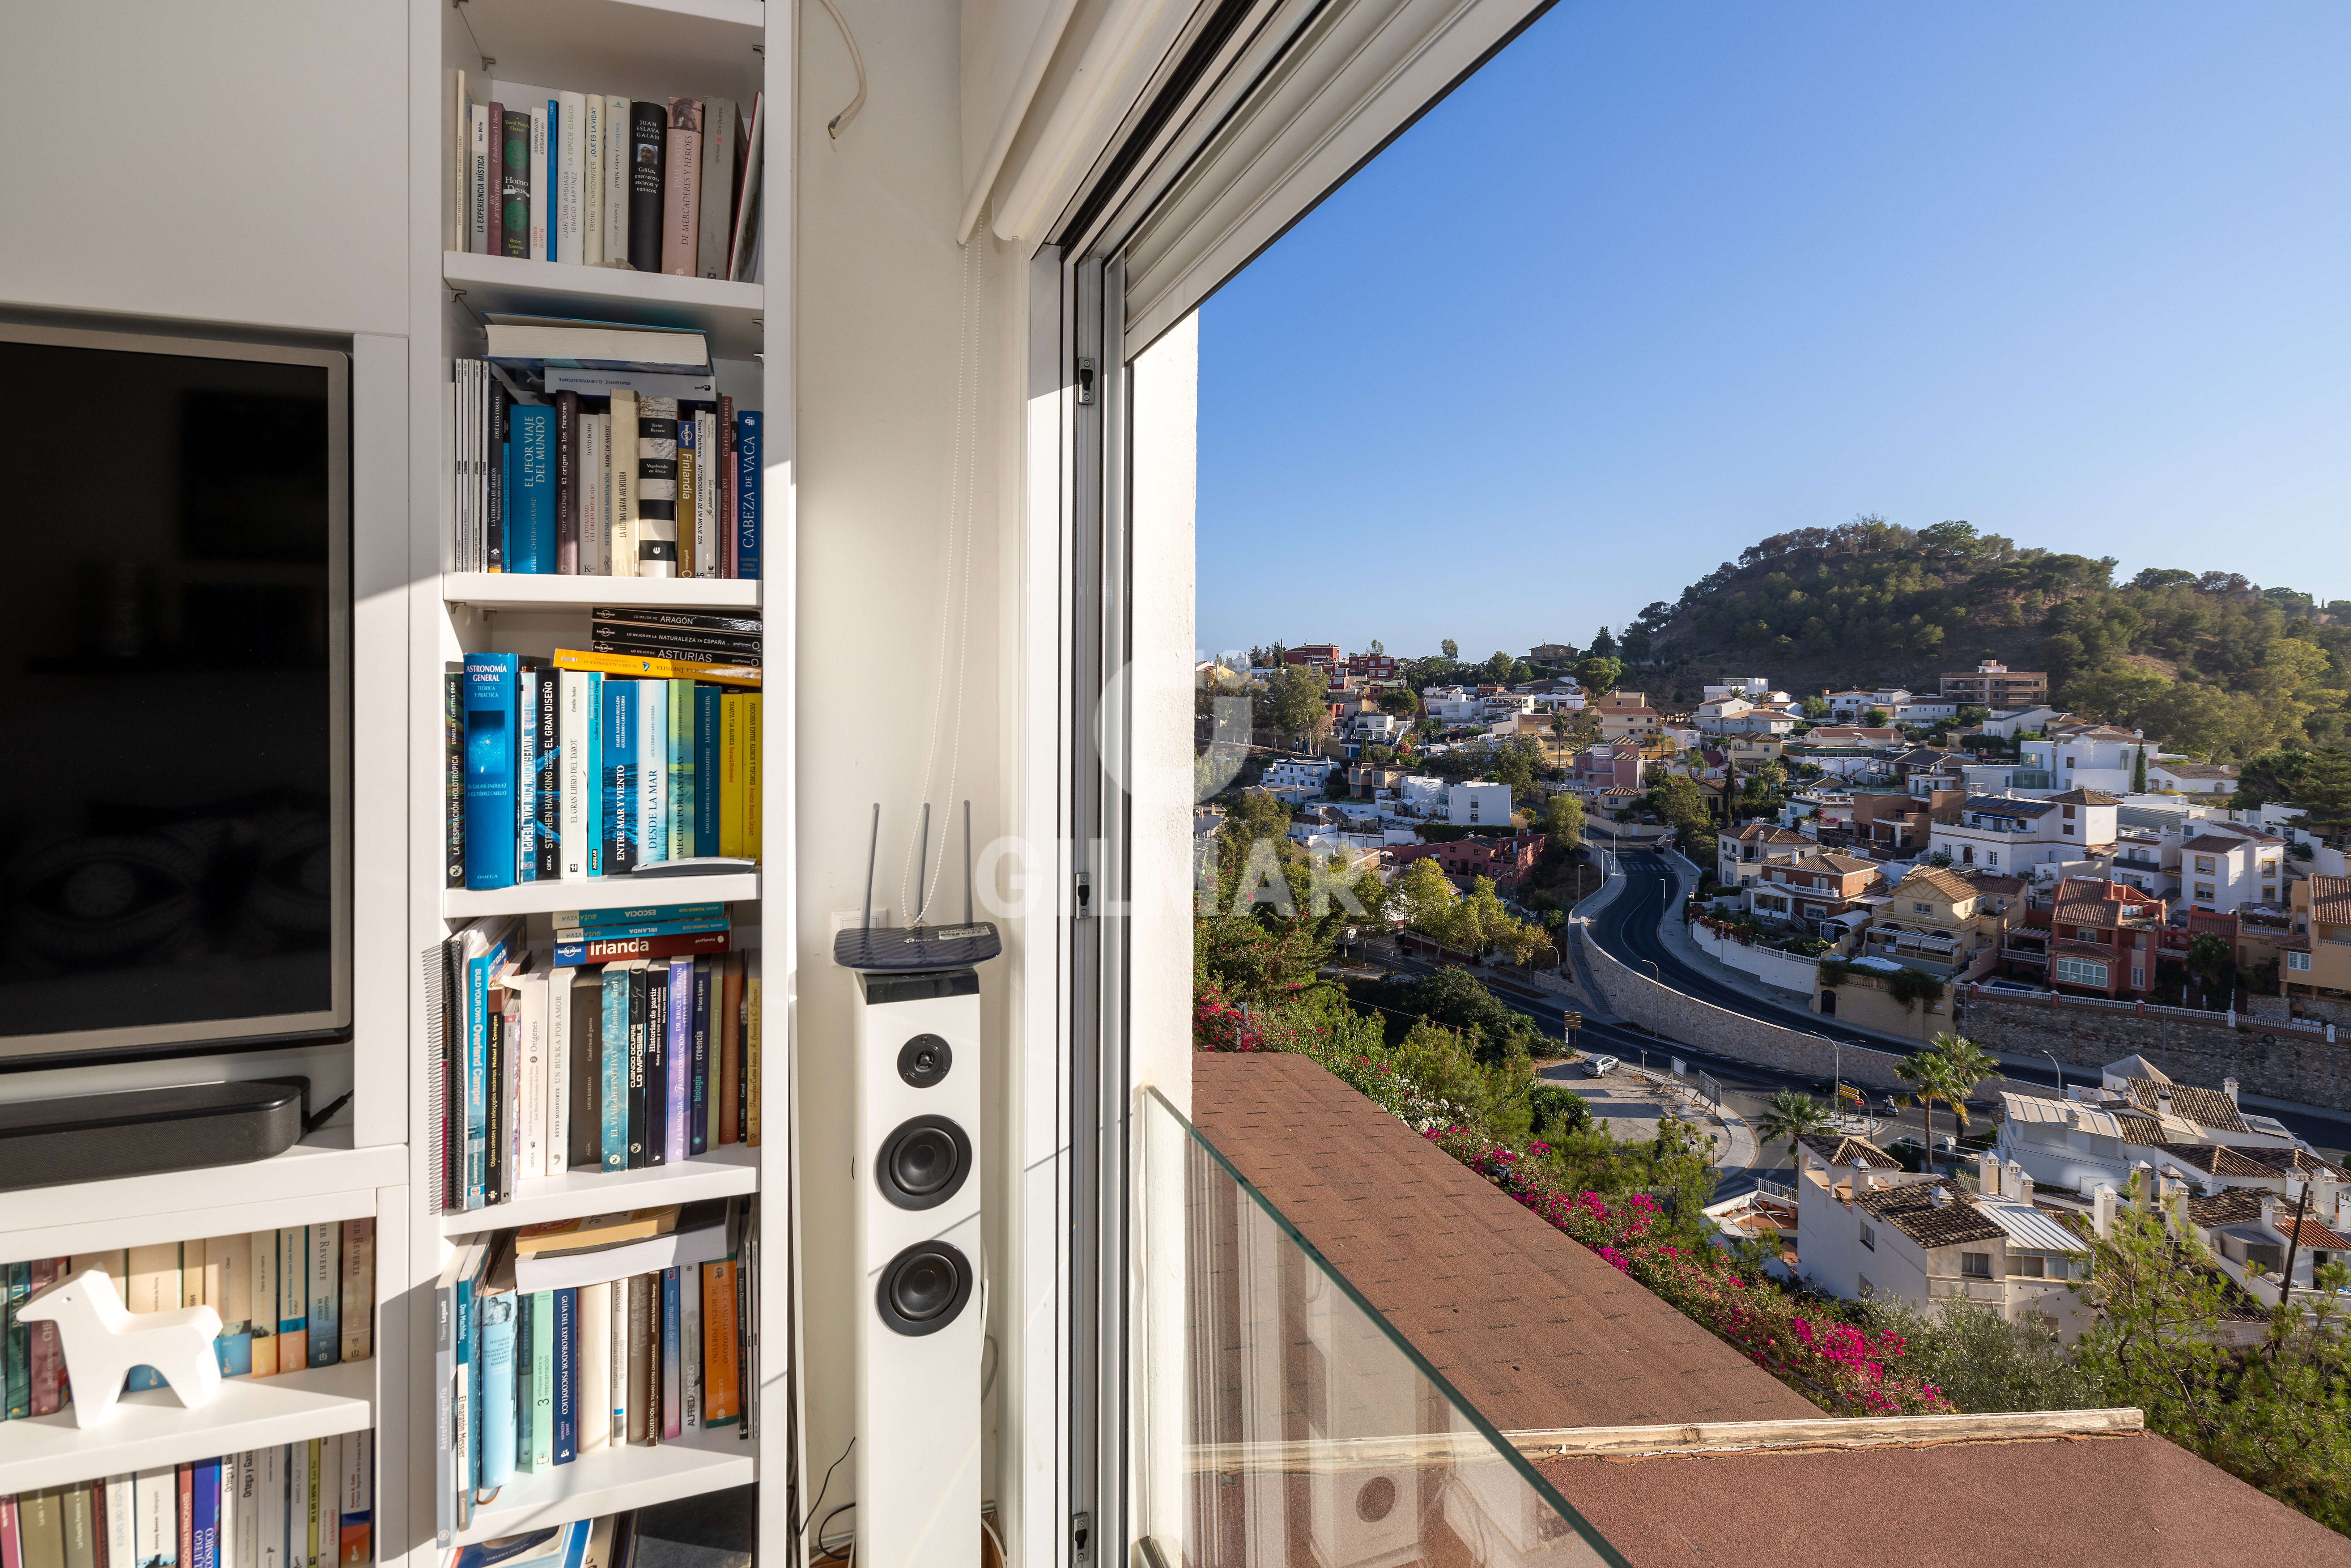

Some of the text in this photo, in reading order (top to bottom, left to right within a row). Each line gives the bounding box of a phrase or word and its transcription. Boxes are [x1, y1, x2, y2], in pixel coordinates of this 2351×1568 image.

[591, 125, 596, 133] LA
[637, 132, 659, 140] GALÁN
[505, 177, 528, 186] Homo
[507, 185, 527, 194] Deus
[682, 178, 691, 232] MERCADERES
[681, 234, 688, 245] DE
[524, 417, 533, 487] EL PEOR VIAJE
[536, 416, 545, 483] DEL MUNDO
[683, 454, 692, 499] Finlandia
[743, 436, 754, 548] CABEZA DE VACA
[618, 511, 626, 530] ÚLTIMA
[660, 616, 693, 625] ARAGÓN
[658, 649, 712, 663] ASTURIAS
[466, 664, 507, 673] ASTRONOMÍA
[473, 673, 499, 682] GENERAL
[543, 681, 552, 711] DISEÑO
[545, 738, 552, 748] EL
[617, 765, 625, 799] VIENTO
[649, 796, 657, 810] LA
[649, 812, 657, 849] DESDE
[453, 845, 459, 855] LA
[591, 938, 649, 956] Irlanda
[650, 1010, 655, 1019] de
[473, 1024, 483, 1068] Overland
[555, 1072, 560, 1083] UN
[637, 1076, 642, 1088] LO
[471, 1068, 483, 1106] Camper
[611, 1126, 618, 1137] EL
[320, 1241, 329, 1281] REVERTE
[353, 1238, 363, 1276] REVERTE
[711, 1286, 717, 1296] DE
[723, 1284, 730, 1295] EL
[440, 1387, 449, 1450] Astrofotografía
[225, 1471, 234, 1492] Ortega
[243, 1474, 254, 1497] Ortega
[194, 1530, 204, 1560] JUEGO
